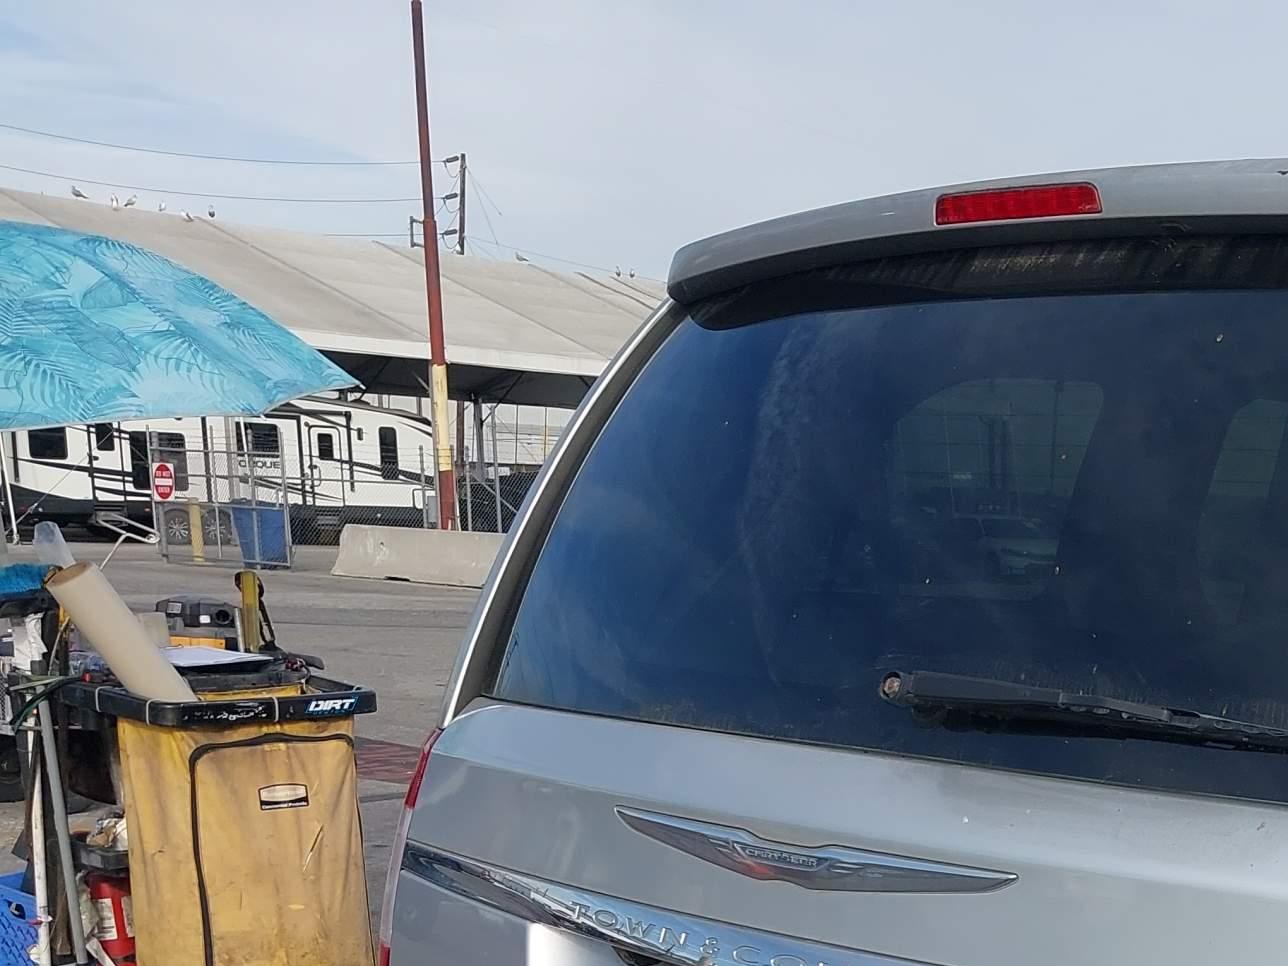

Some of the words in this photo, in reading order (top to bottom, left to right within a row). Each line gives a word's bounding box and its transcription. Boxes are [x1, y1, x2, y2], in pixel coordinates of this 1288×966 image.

[308, 698, 356, 712] DIRT
[569, 900, 690, 946] TOWN
[699, 935, 721, 955] &
